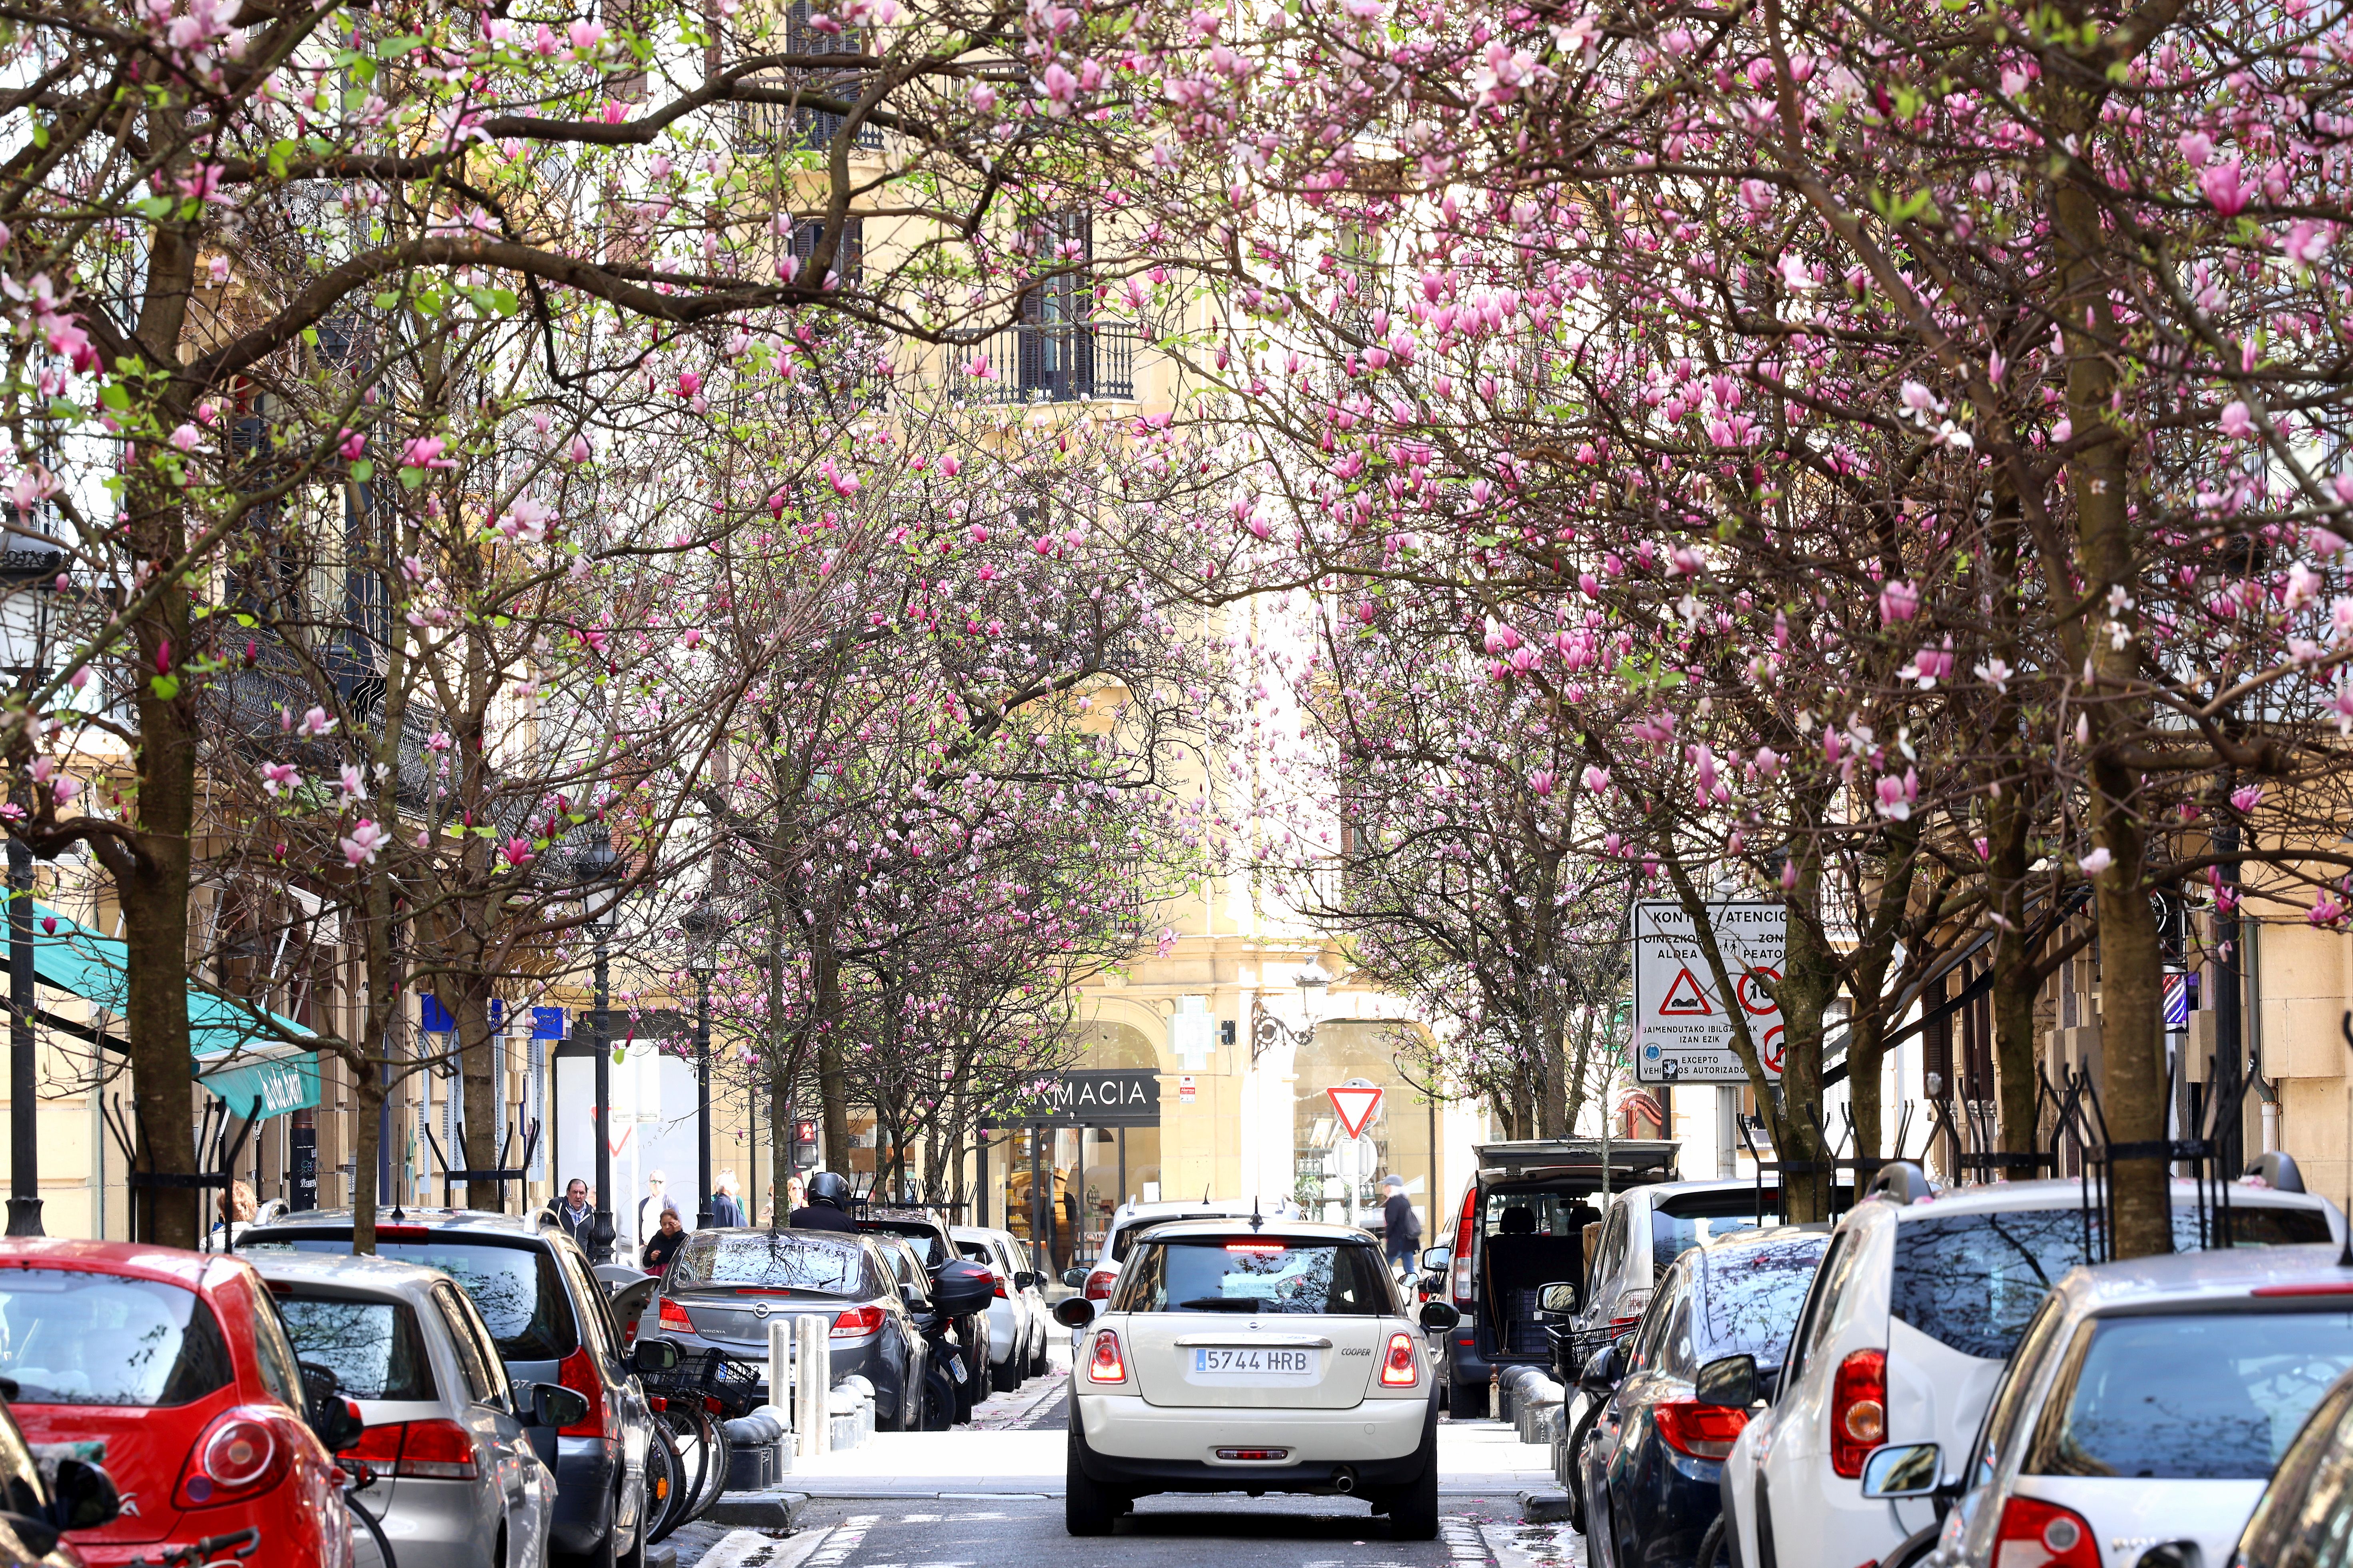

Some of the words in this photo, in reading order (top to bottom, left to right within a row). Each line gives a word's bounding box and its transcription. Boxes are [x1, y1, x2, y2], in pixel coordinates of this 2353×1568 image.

[1654, 912, 1711, 923] KONT
[1726, 912, 1786, 922] ATENCIO
[1644, 934, 1702, 943] OINEZKO
[1759, 934, 1786, 943] ZON
[1658, 950, 1698, 958] ALDEA
[1744, 950, 1786, 959] PEATO
[995, 1081, 1147, 1105] MACIA
[1208, 1351, 1260, 1369] 5744
[1268, 1352, 1306, 1371] HRB
[511, 1379, 529, 1390] 07
